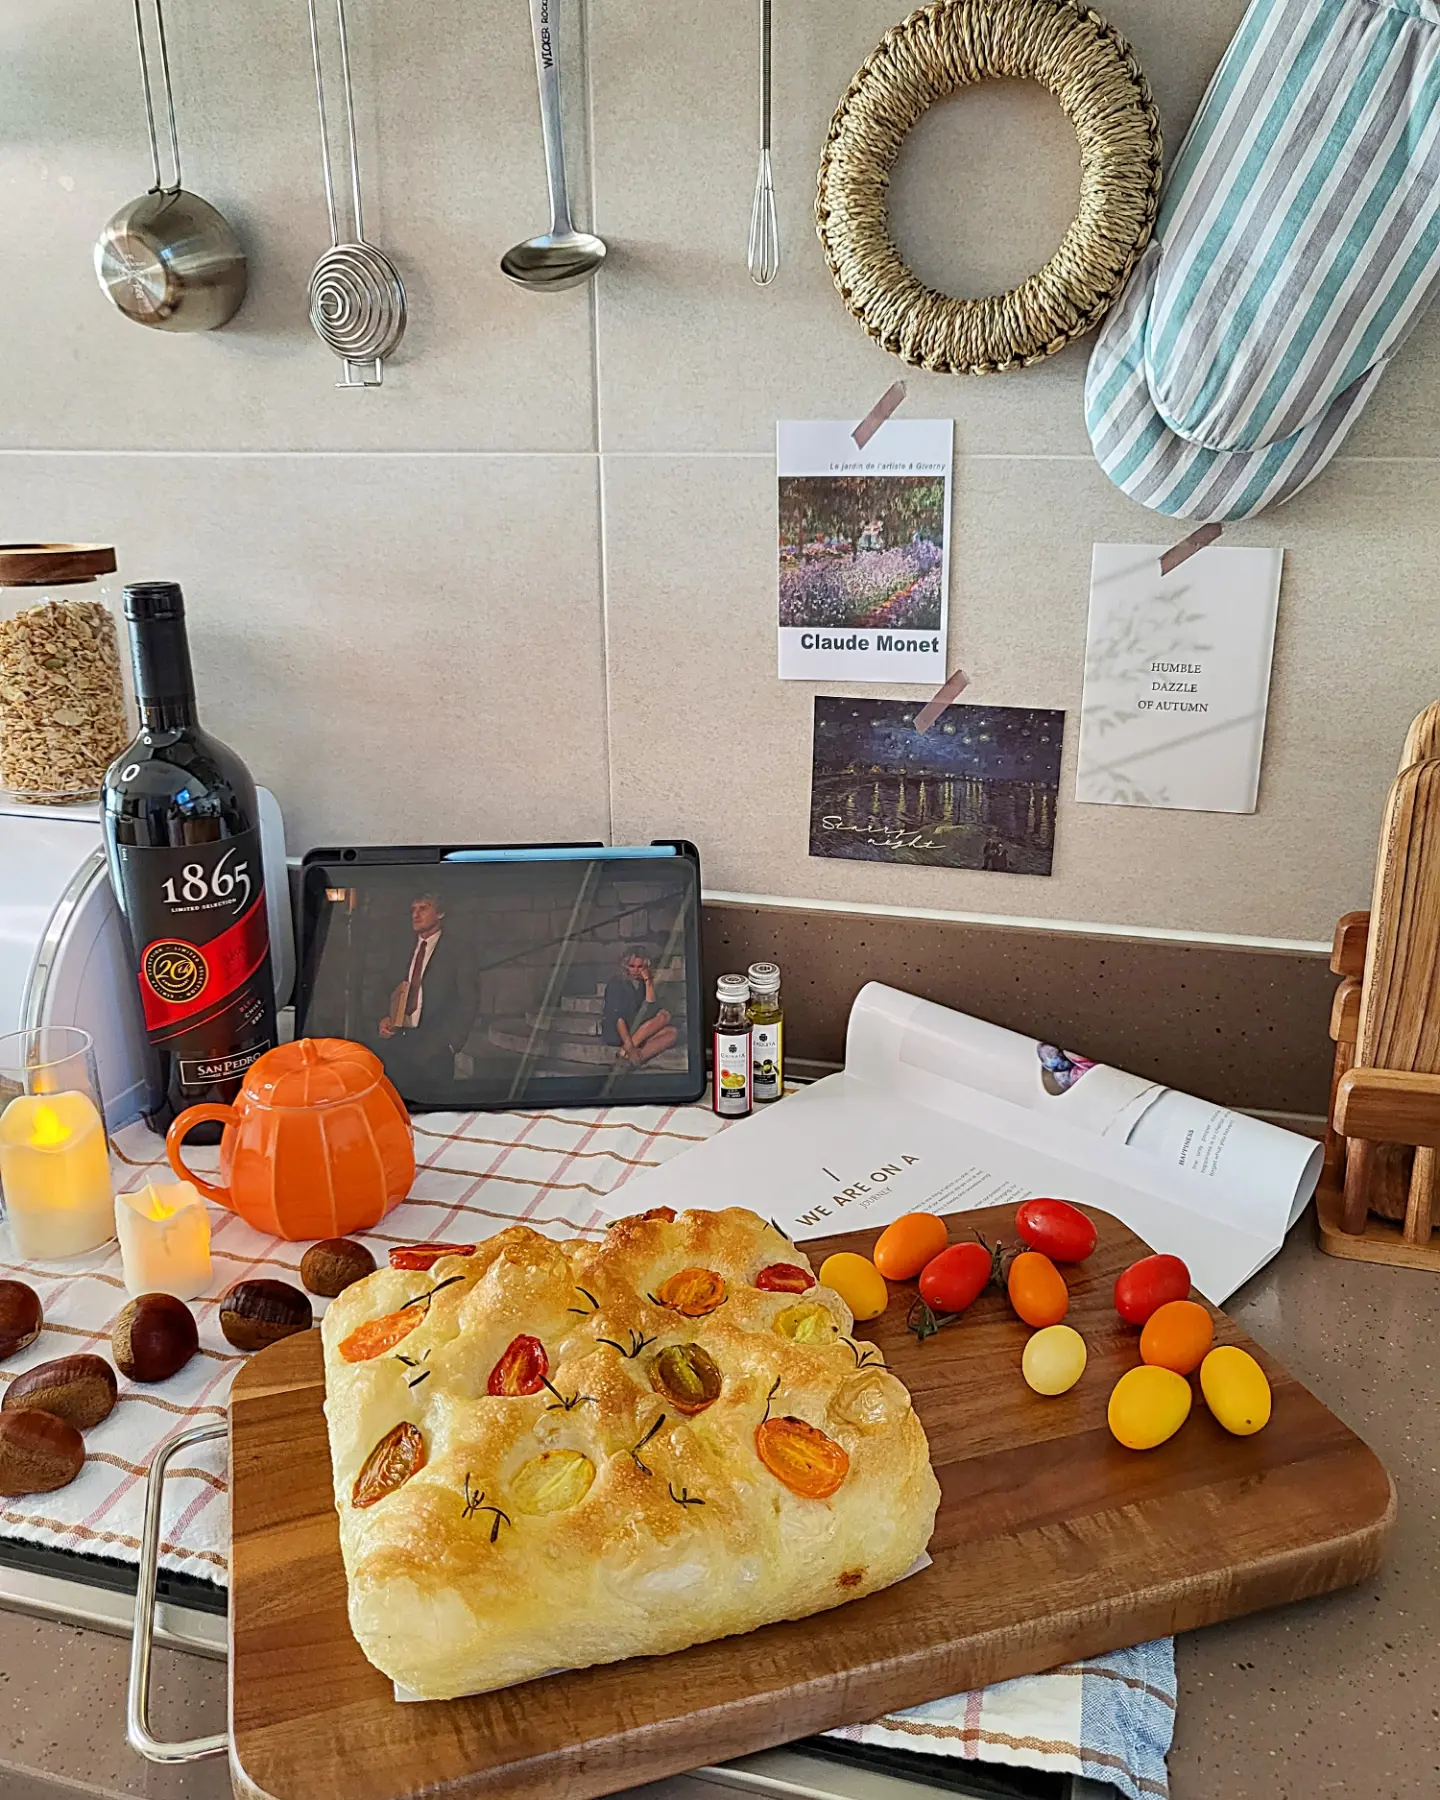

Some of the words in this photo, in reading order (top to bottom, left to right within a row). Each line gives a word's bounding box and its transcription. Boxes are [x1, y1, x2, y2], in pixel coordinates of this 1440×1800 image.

[541, 0, 549, 23] ROCK
[865, 462, 875, 470] de
[801, 634, 870, 651] Claude
[876, 635, 939, 653] Monet
[1151, 662, 1202, 674] HUMBLE
[1152, 682, 1198, 693] DAZZLE
[1138, 700, 1154, 710] OF
[1155, 701, 1209, 713] AUTUMN
[822, 815, 921, 839] Starry
[867, 834, 946, 850] night
[161, 847, 251, 915] 1865
[171, 905, 200, 913] LIMITED
[201, 898, 237, 910] SELECTION
[1178, 1129, 1194, 1166] HAPPINESS
[795, 1205, 834, 1226] WE
[832, 1181, 872, 1207] ARE
[870, 1163, 903, 1183] ON
[901, 1154, 920, 1165] A
